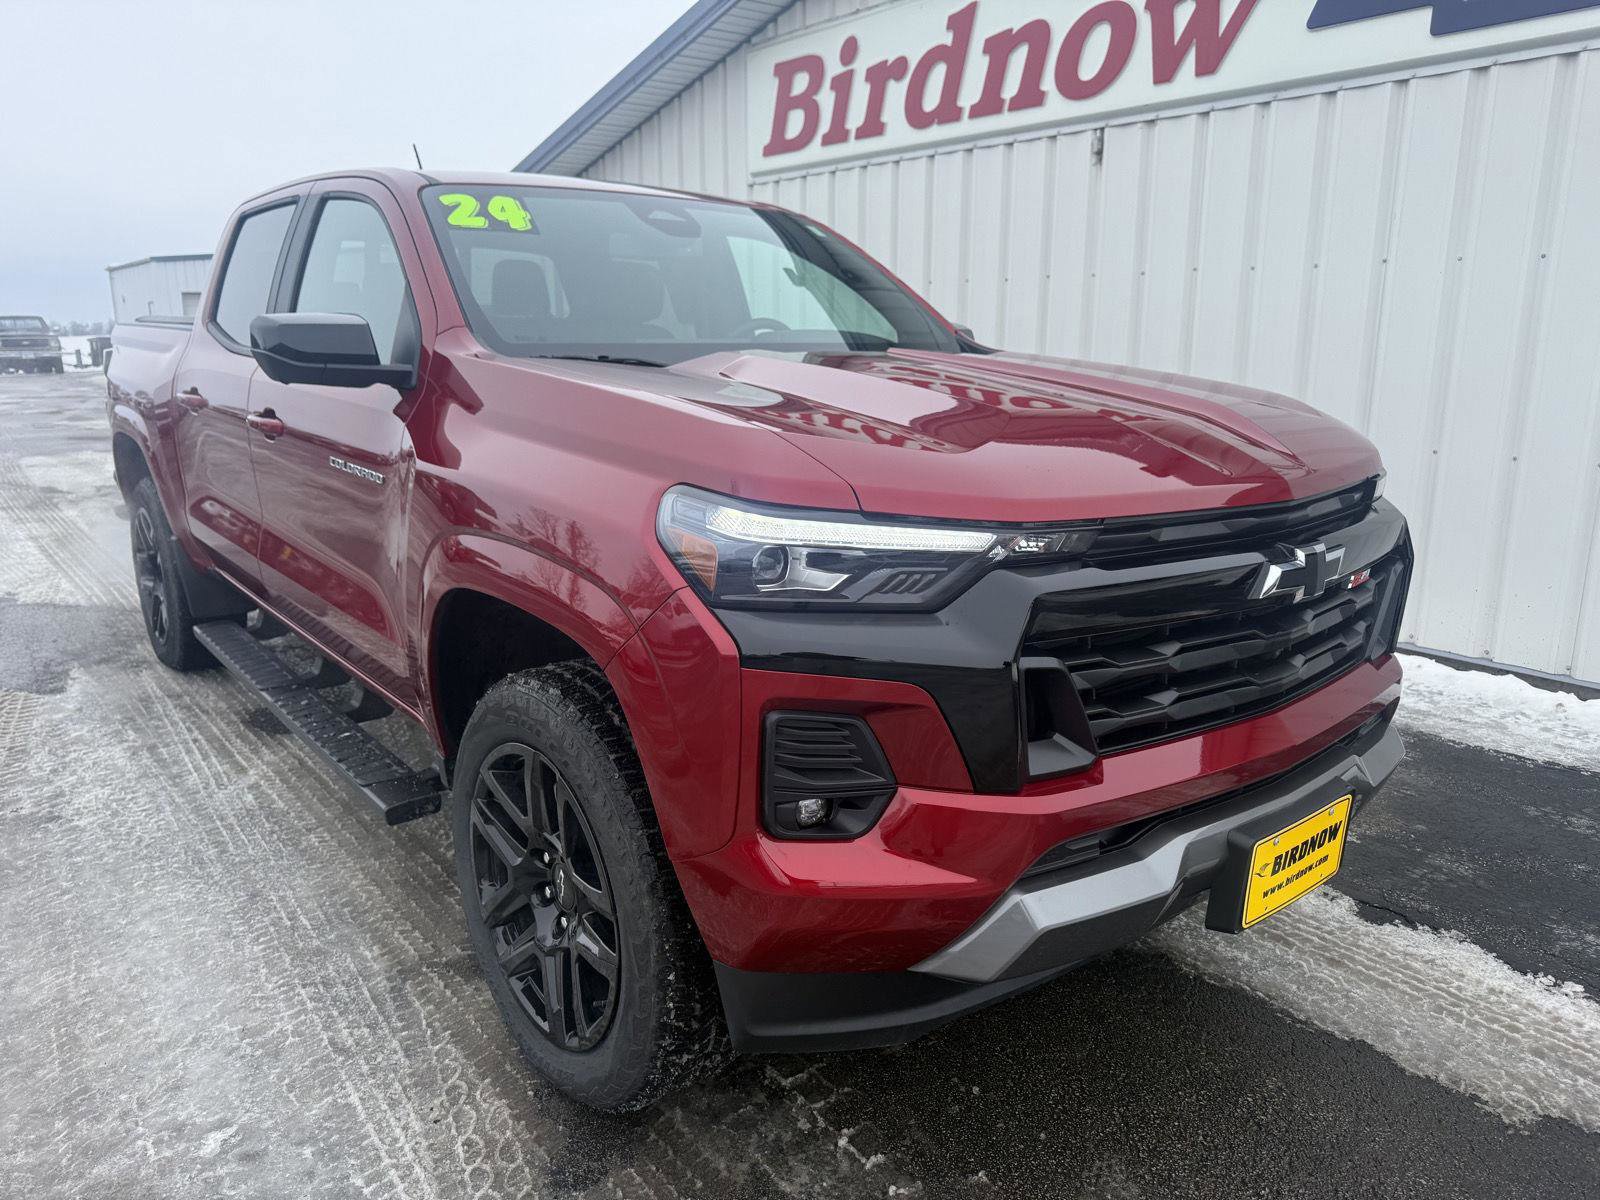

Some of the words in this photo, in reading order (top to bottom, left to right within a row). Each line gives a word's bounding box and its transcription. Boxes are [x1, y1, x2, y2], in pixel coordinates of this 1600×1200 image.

[763, 0, 1259, 157] Birdnow
[438, 193, 532, 231] 24
[329, 456, 384, 484] COLORADO
[1270, 820, 1342, 876] BIRDNOW
[1262, 854, 1329, 899] www.birdnow.com
